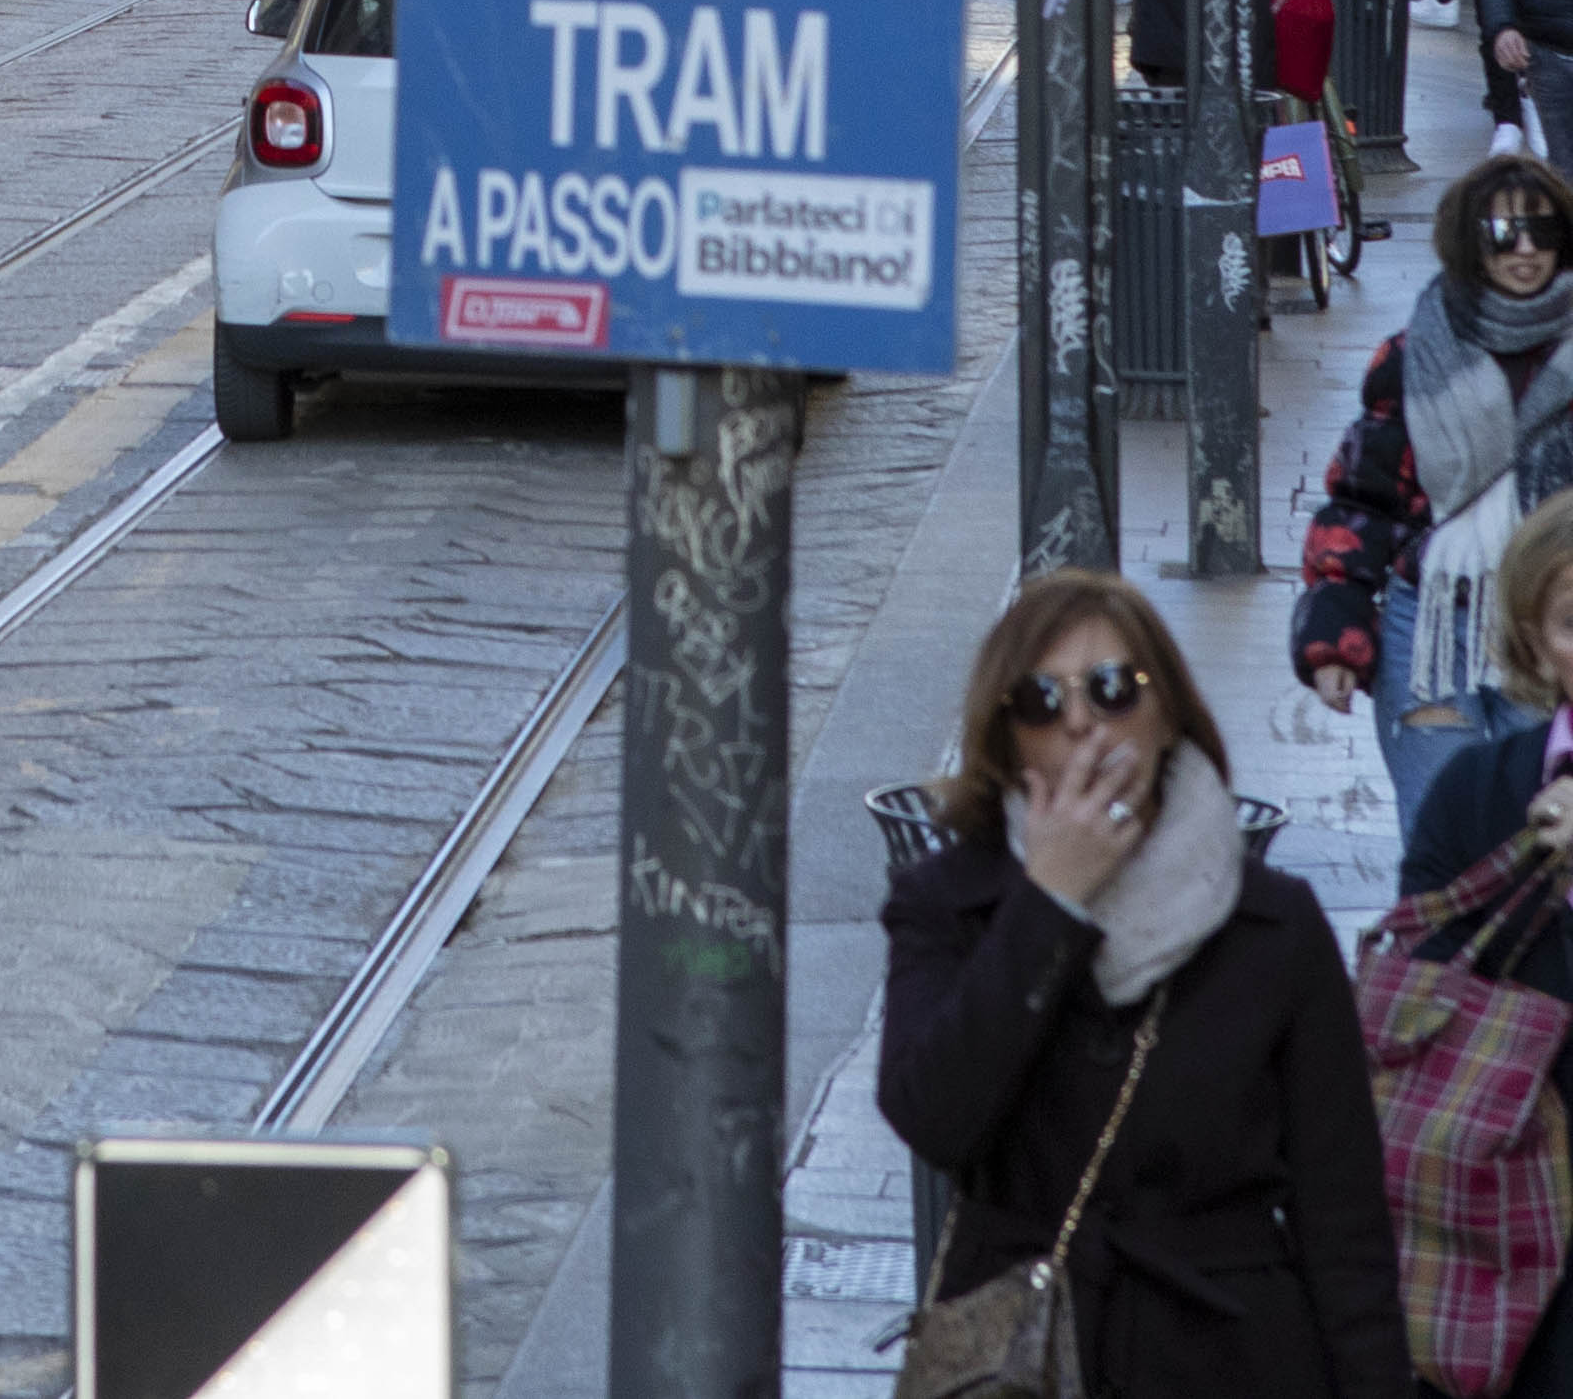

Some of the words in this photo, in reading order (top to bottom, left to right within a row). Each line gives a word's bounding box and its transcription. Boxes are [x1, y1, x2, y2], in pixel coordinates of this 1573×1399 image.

[530, 0, 830, 161] TRAM
[421, 165, 467, 268] A
[477, 169, 678, 279] PASSO
[697, 189, 865, 235] Parlateci
[698, 234, 914, 288] Bibbiano!
